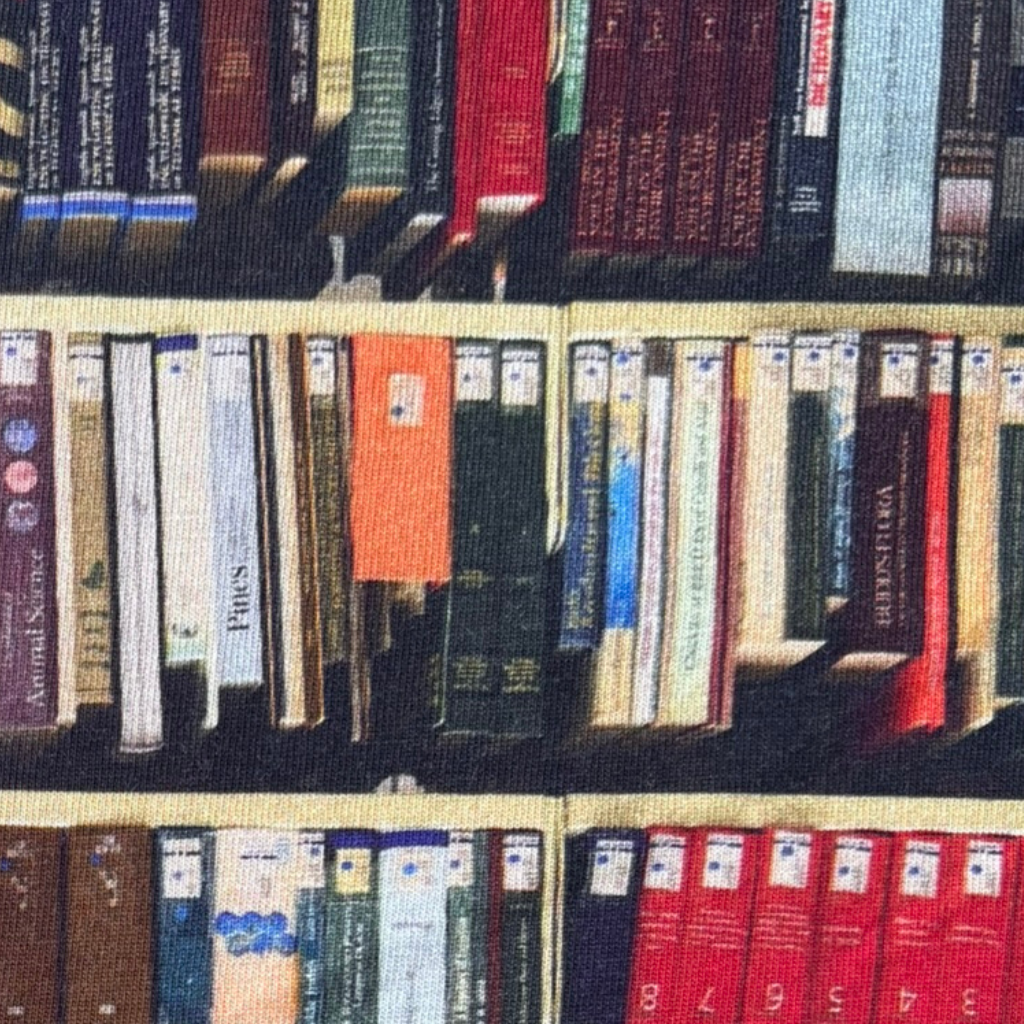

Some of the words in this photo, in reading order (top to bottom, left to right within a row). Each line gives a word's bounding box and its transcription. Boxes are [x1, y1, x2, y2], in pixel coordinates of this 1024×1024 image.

[808, 1, 834, 107] DICTIONARY
[23, 547, 45, 625] Science
[226, 564, 250, 632] Pines
[25, 628, 47, 707] Animal
[640, 983, 659, 1011] 8
[697, 985, 716, 1013] 7
[827, 985, 846, 1012] 5
[898, 986, 918, 1013] 4
[961, 987, 978, 1016] 3
